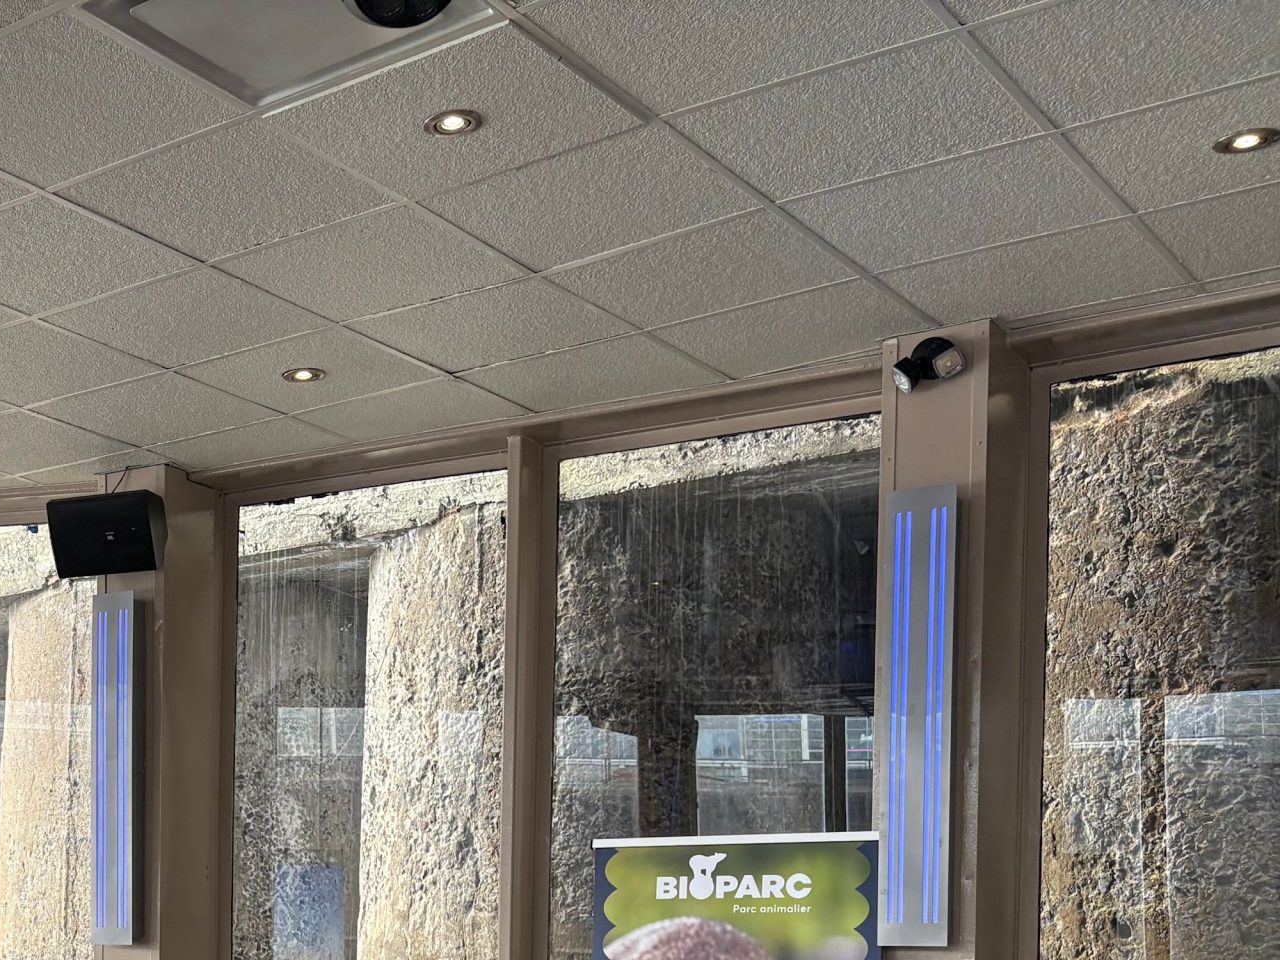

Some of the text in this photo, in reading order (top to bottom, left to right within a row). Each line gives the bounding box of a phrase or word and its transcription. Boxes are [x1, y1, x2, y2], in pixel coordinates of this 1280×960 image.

[656, 871, 812, 900] BIOPARC
[733, 904, 811, 913] Parc animalier
